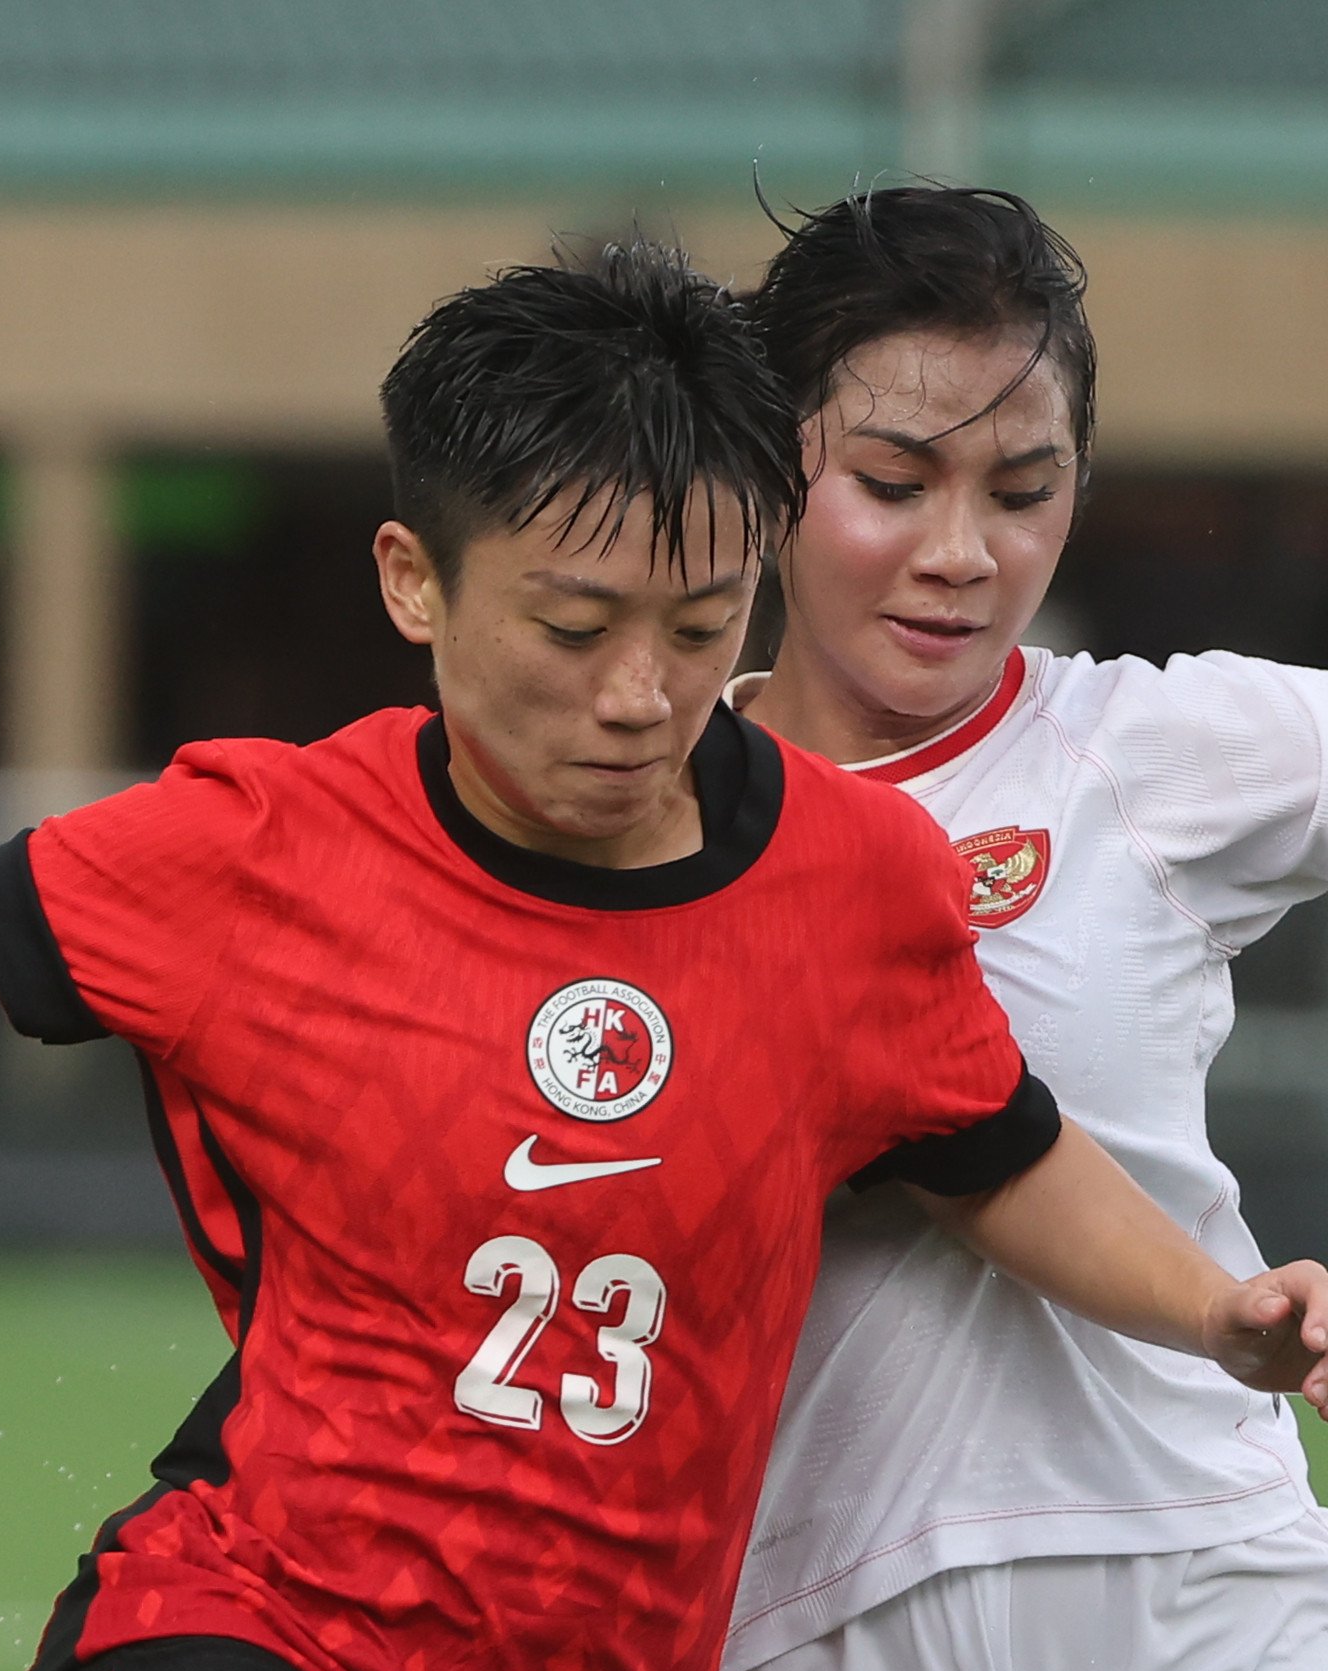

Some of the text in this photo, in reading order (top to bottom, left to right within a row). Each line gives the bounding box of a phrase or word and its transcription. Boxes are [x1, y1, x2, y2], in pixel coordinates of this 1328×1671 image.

[955, 832, 1012, 853] INDONESIA
[538, 984, 665, 1043] THE FOOTBALL ASSOCIATION
[542, 1078, 647, 1117] HONG KONG, CHINA
[454, 1235, 668, 1446] 23
